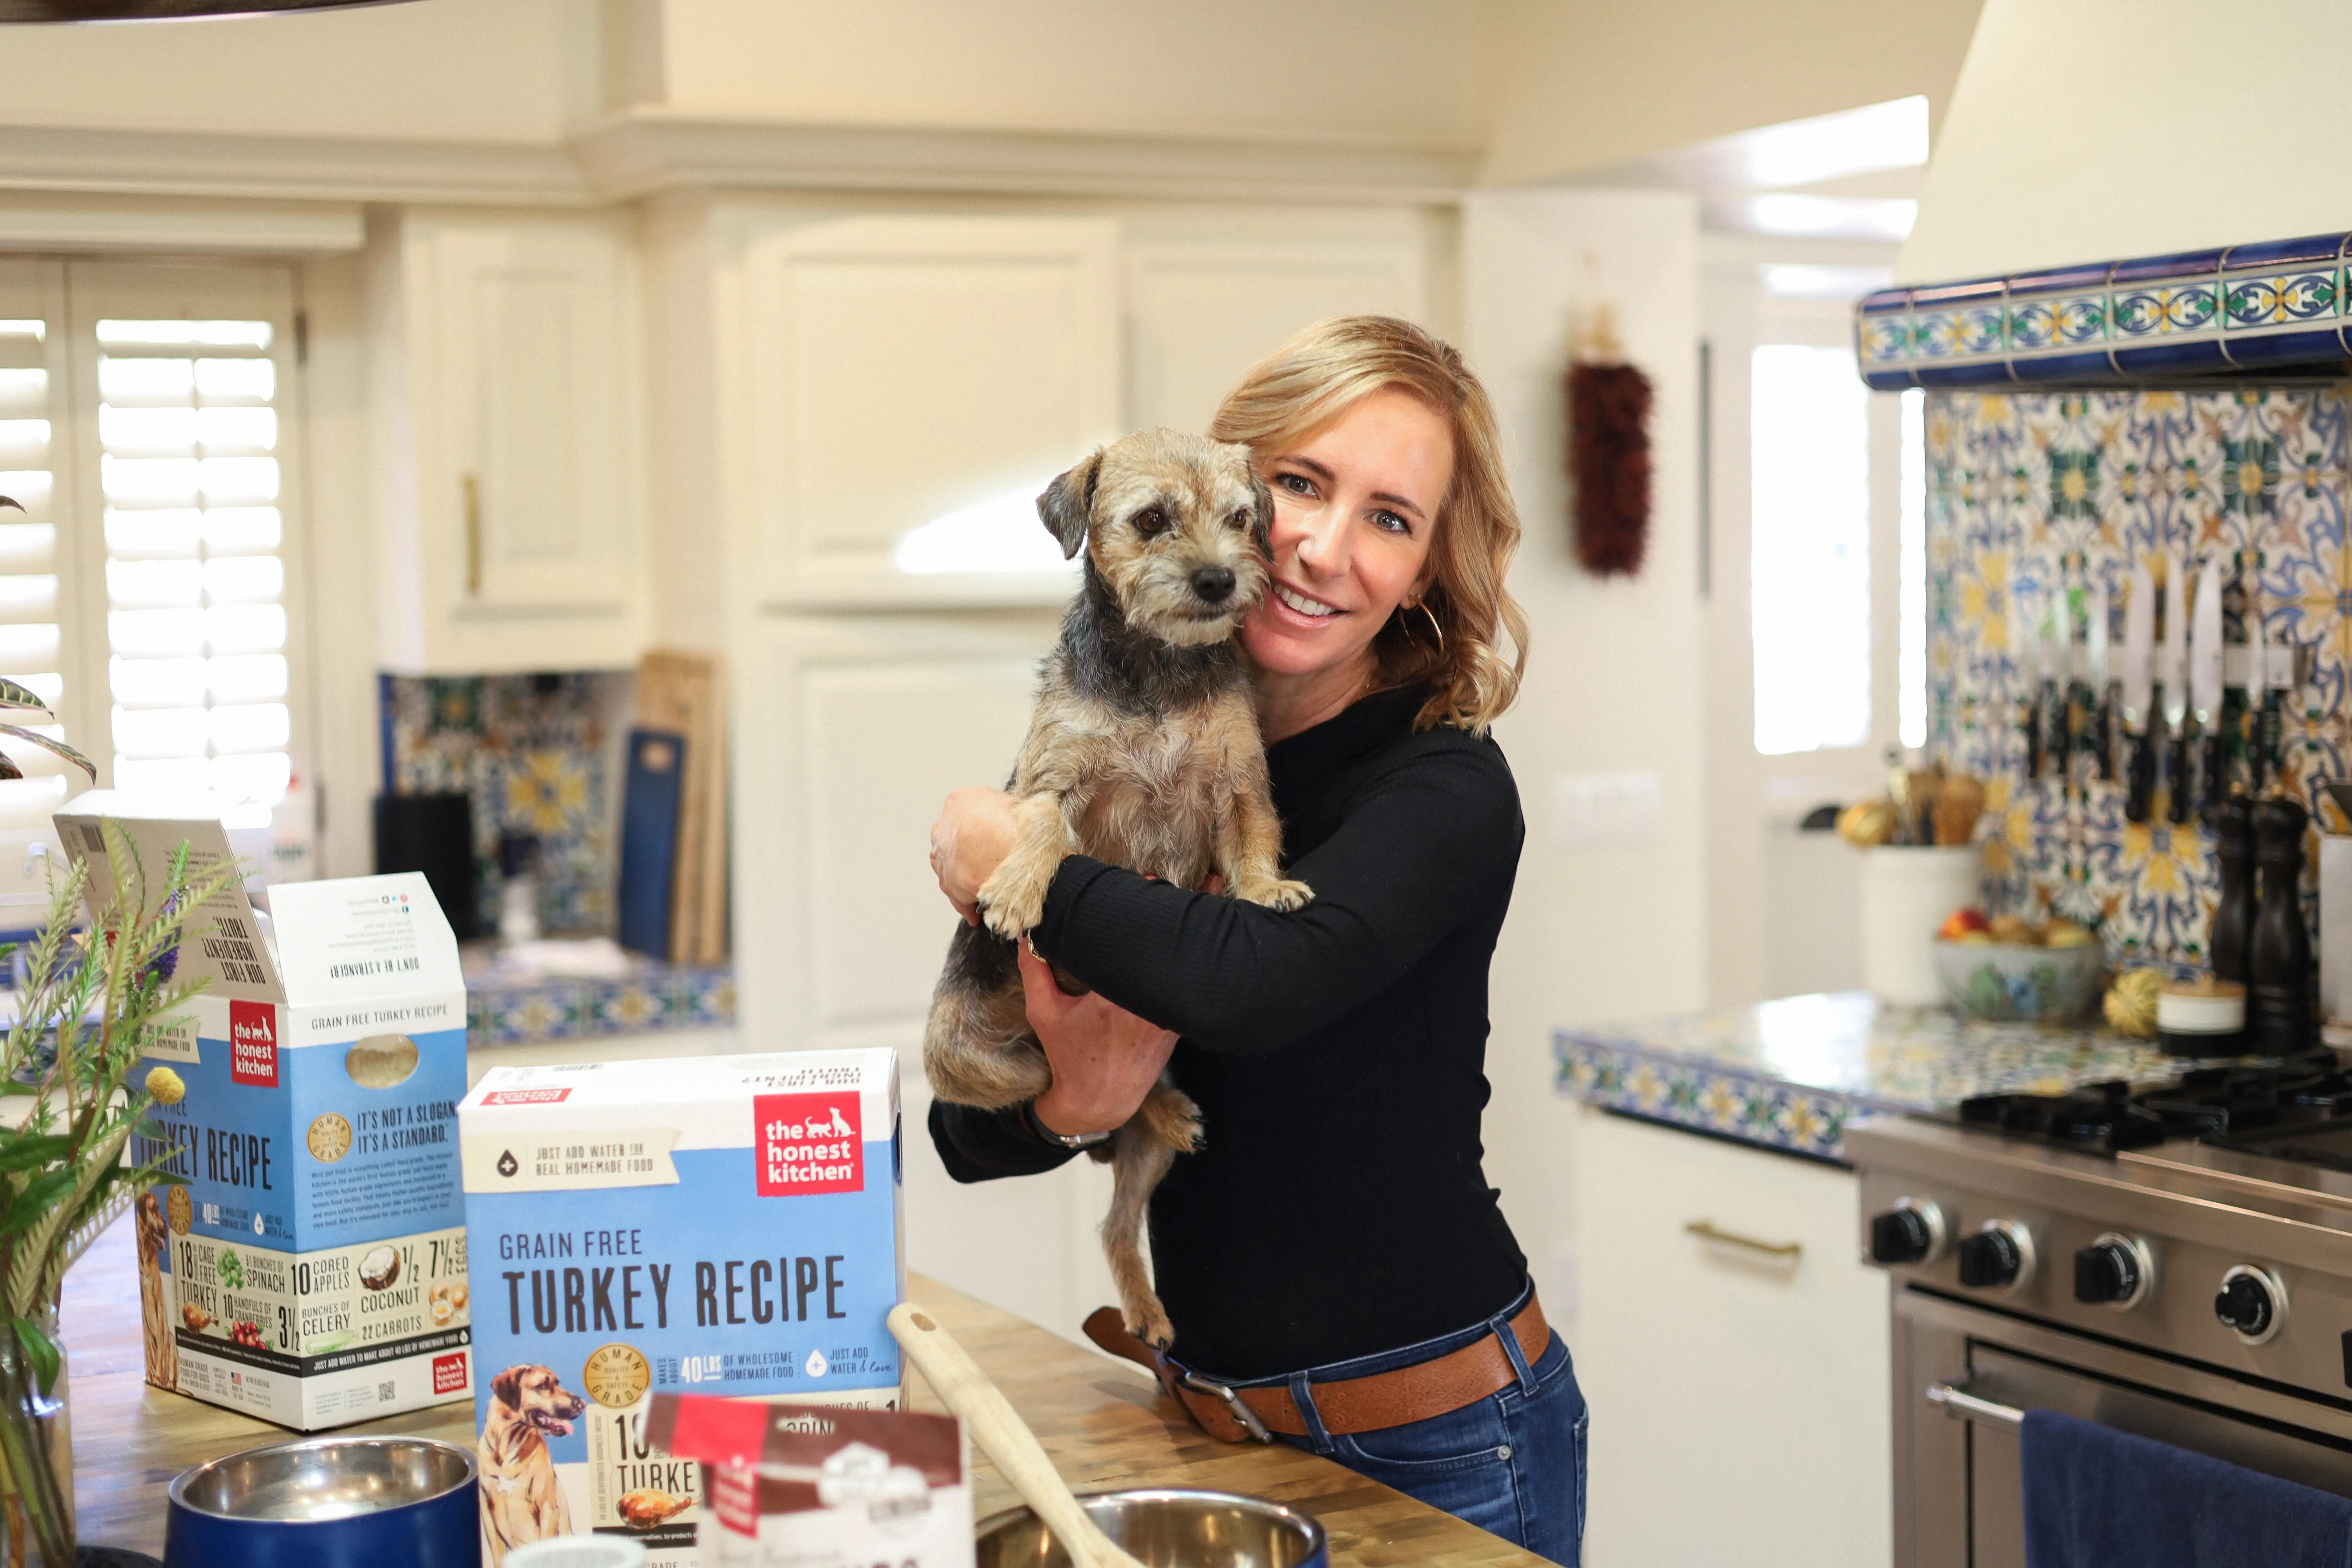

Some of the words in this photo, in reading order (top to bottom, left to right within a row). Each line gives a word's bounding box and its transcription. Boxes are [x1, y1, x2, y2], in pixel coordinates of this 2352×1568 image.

[202, 937, 258, 962] INGREDIENT?
[220, 961, 247, 982] FIRST
[245, 963, 266, 984] OUR
[312, 1016, 342, 1030] GRAIN
[346, 1012, 370, 1026] FREE
[374, 1009, 411, 1023] TURKEY
[415, 1003, 447, 1018] RECIPE
[234, 1021, 251, 1039] the
[235, 1038, 272, 1060] honest
[236, 1057, 273, 1077] kitchen
[358, 1110, 377, 1131] IT'S
[382, 1107, 402, 1128] NOT
[407, 1106, 413, 1124] A
[765, 1120, 804, 1141] the
[359, 1133, 378, 1154] IT'S
[383, 1132, 388, 1151] A
[536, 1147, 561, 1160] JUST
[566, 1145, 584, 1159] ADD
[590, 1144, 625, 1158] WATER
[767, 1140, 851, 1162] honest
[207, 1127, 272, 1190] RECIPE
[536, 1162, 560, 1176] REAL
[566, 1159, 623, 1175] HOMEMADE
[628, 1158, 653, 1172] FOOD
[768, 1161, 853, 1184] kitchen
[198, 1244, 215, 1265] CAGE
[500, 1232, 572, 1260] GRAIN
[584, 1229, 642, 1257] FREE
[179, 1240, 193, 1279] 18
[254, 1256, 276, 1272] BUNCHES
[277, 1260, 283, 1273] OF
[200, 1265, 217, 1286] FREE
[246, 1268, 285, 1294] SPINACH
[291, 1262, 310, 1296] 10
[313, 1256, 349, 1275] CORED
[314, 1271, 350, 1294] APPLES
[181, 1280, 217, 1314] TURKEY
[223, 1294, 233, 1319] 10
[234, 1296, 262, 1313] HANDFULS
[264, 1302, 271, 1315] OF
[361, 1286, 421, 1314] COCONUT
[502, 1263, 671, 1335] TURKEY
[695, 1256, 846, 1327] RECIPE
[302, 1303, 338, 1319] BUNCHES
[341, 1300, 350, 1314] OF
[303, 1313, 351, 1337] CELERY
[363, 1326, 373, 1340] 22
[376, 1315, 422, 1338] CARROTS
[314, 1361, 327, 1371] JUST
[328, 1358, 338, 1369] ADD
[339, 1355, 356, 1367] WATER
[357, 1353, 363, 1363] TO
[364, 1351, 377, 1361] MAKE
[378, 1348, 394, 1359] ABOUT
[591, 1348, 643, 1371] HUMAN
[830, 1348, 850, 1360] JUST
[853, 1347, 868, 1359] ADD
[658, 1358, 666, 1384] MAKES
[668, 1358, 678, 1384] ABOUT
[681, 1356, 702, 1383] 40
[704, 1355, 721, 1373] LBS
[724, 1355, 733, 1367] OF
[738, 1352, 793, 1366] WHOLESOME
[724, 1367, 770, 1381] HOMEMADE
[773, 1366, 793, 1378] FOOD
[830, 1362, 857, 1375] WATER
[870, 1361, 894, 1373] love
[592, 1383, 643, 1404] GRADE
[617, 1462, 695, 1493] TURKE
